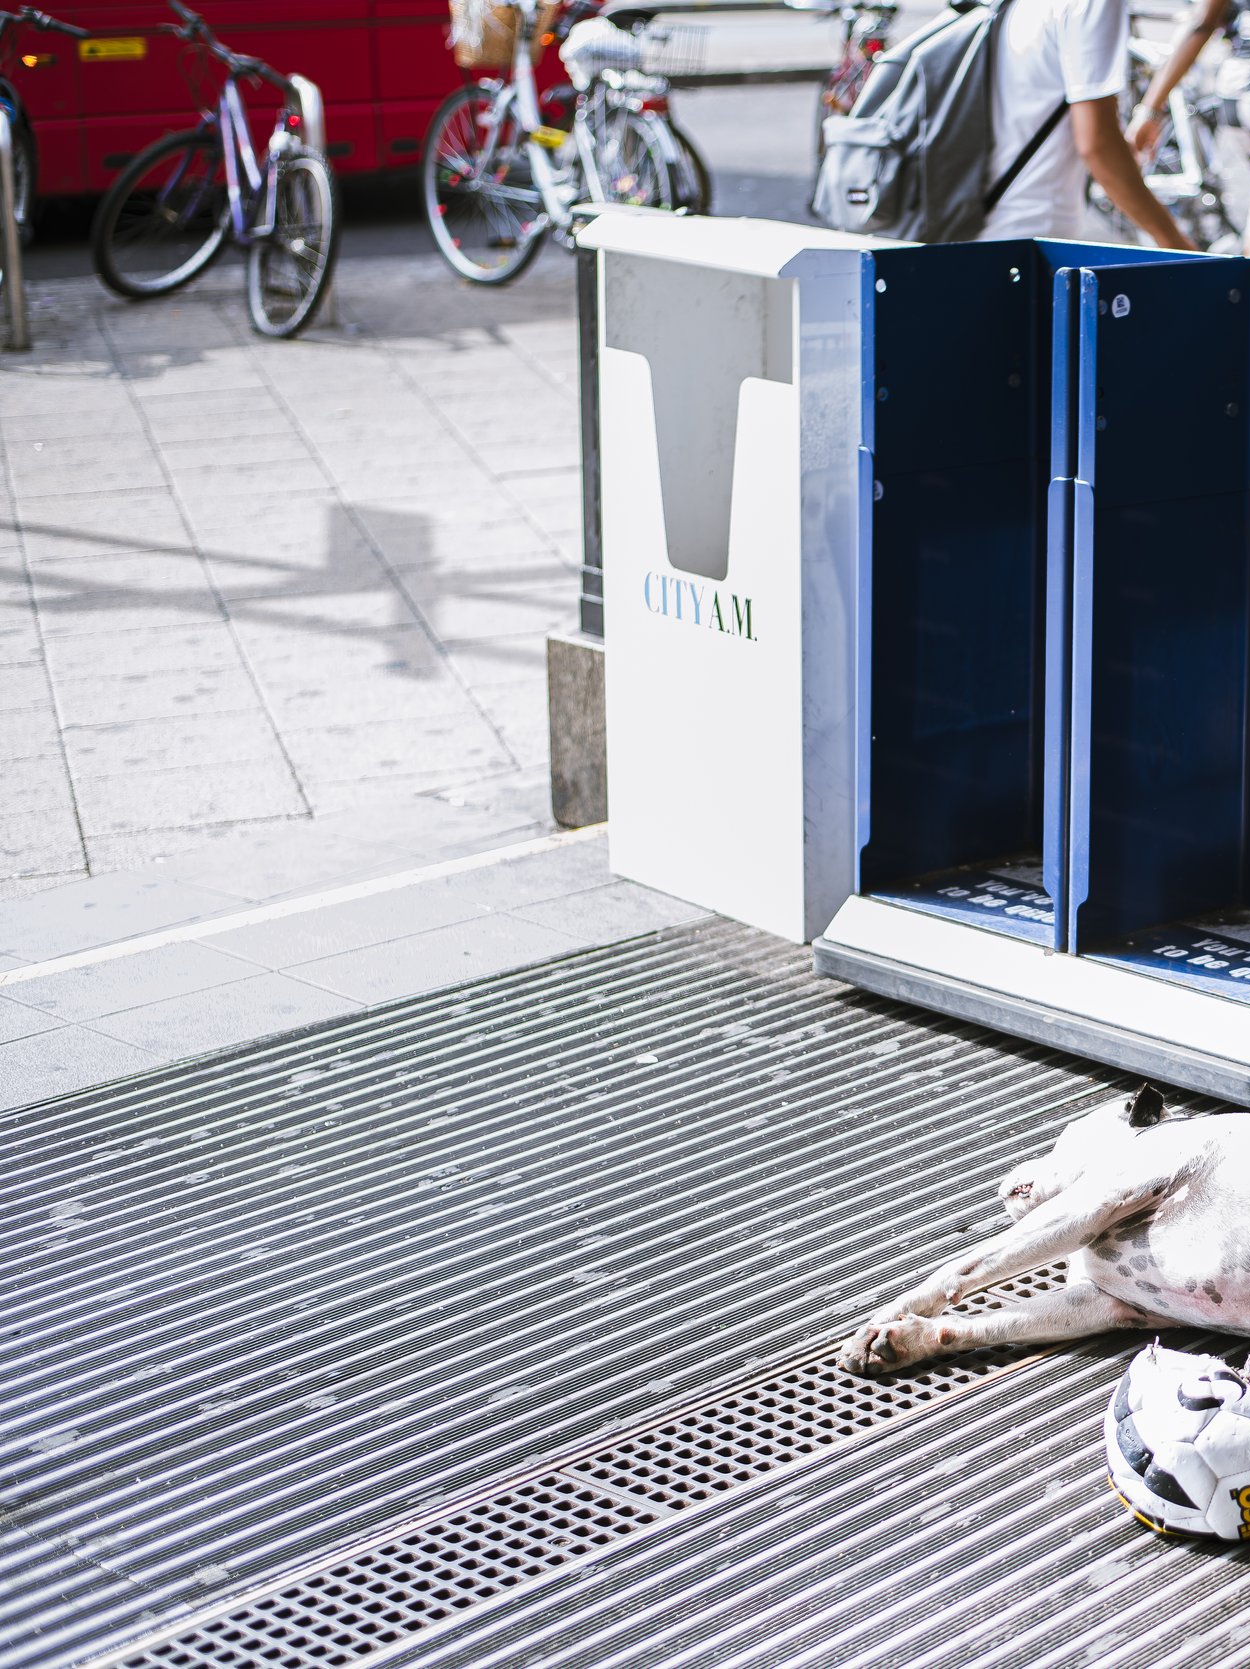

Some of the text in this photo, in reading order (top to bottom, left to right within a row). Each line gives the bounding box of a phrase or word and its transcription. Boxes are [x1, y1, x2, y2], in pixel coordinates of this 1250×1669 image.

[644, 571, 758, 642] CITY A.M.
[937, 886, 971, 897] to
[967, 894, 1008, 907] be
[1152, 944, 1189, 958] to
[1186, 954, 1230, 969] be
